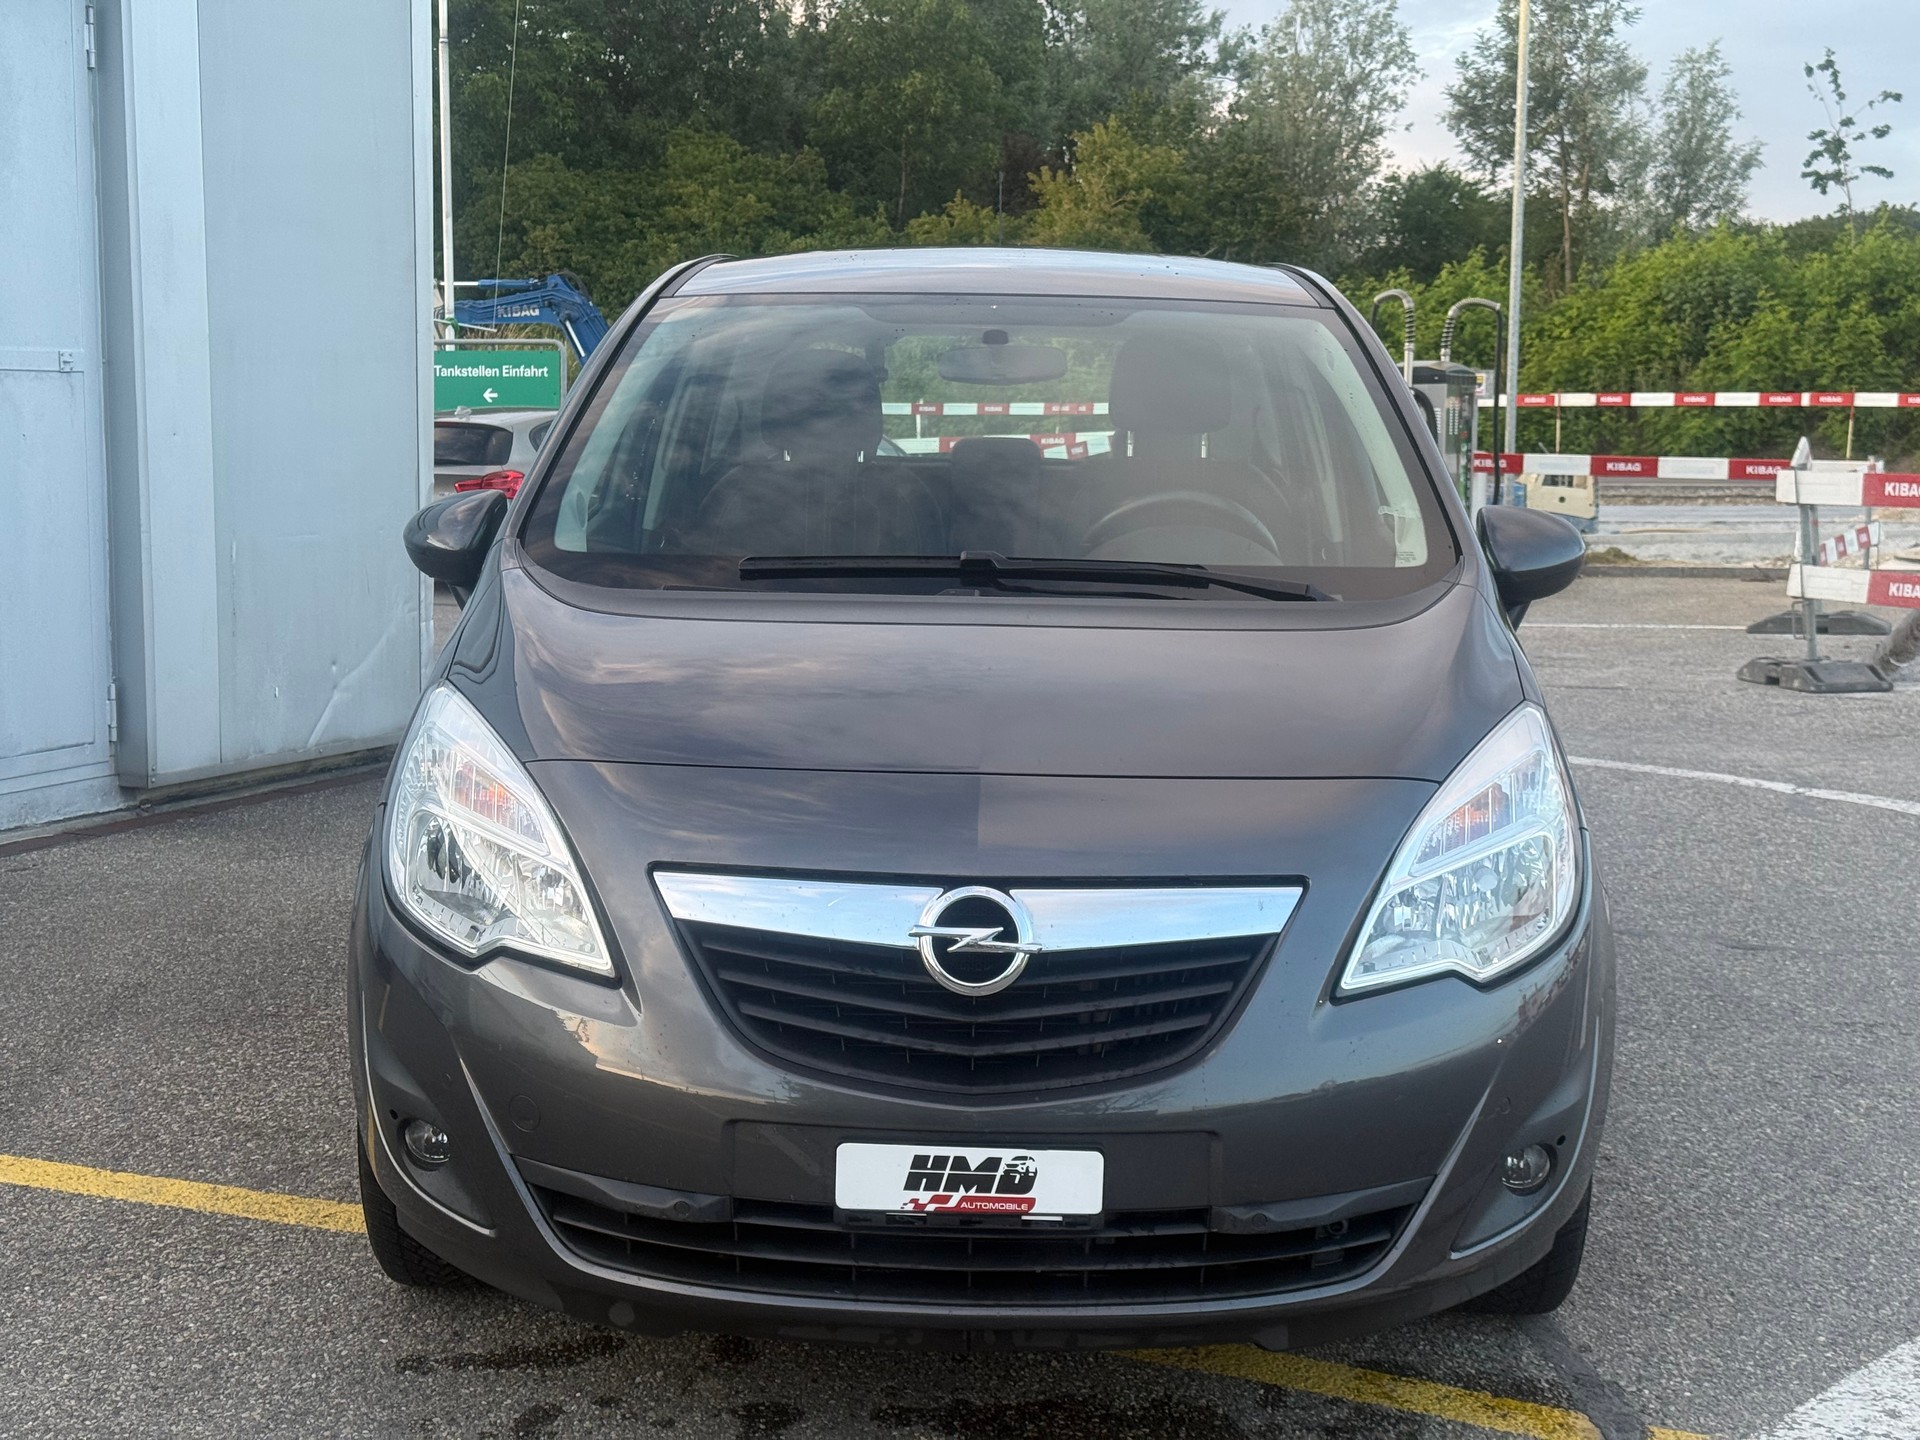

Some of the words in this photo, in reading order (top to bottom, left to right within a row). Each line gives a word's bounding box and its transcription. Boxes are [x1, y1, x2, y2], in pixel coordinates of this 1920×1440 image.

[497, 304, 540, 318] KIBAG
[434, 365, 499, 377] Tankstellen
[502, 365, 548, 377] Einfahrt
[1473, 459, 1507, 468] KIBG
[1606, 462, 1642, 471] KIBAG
[1884, 481, 1920, 497] KIBA
[960, 1201, 1029, 1211] AUTOMOBILE
